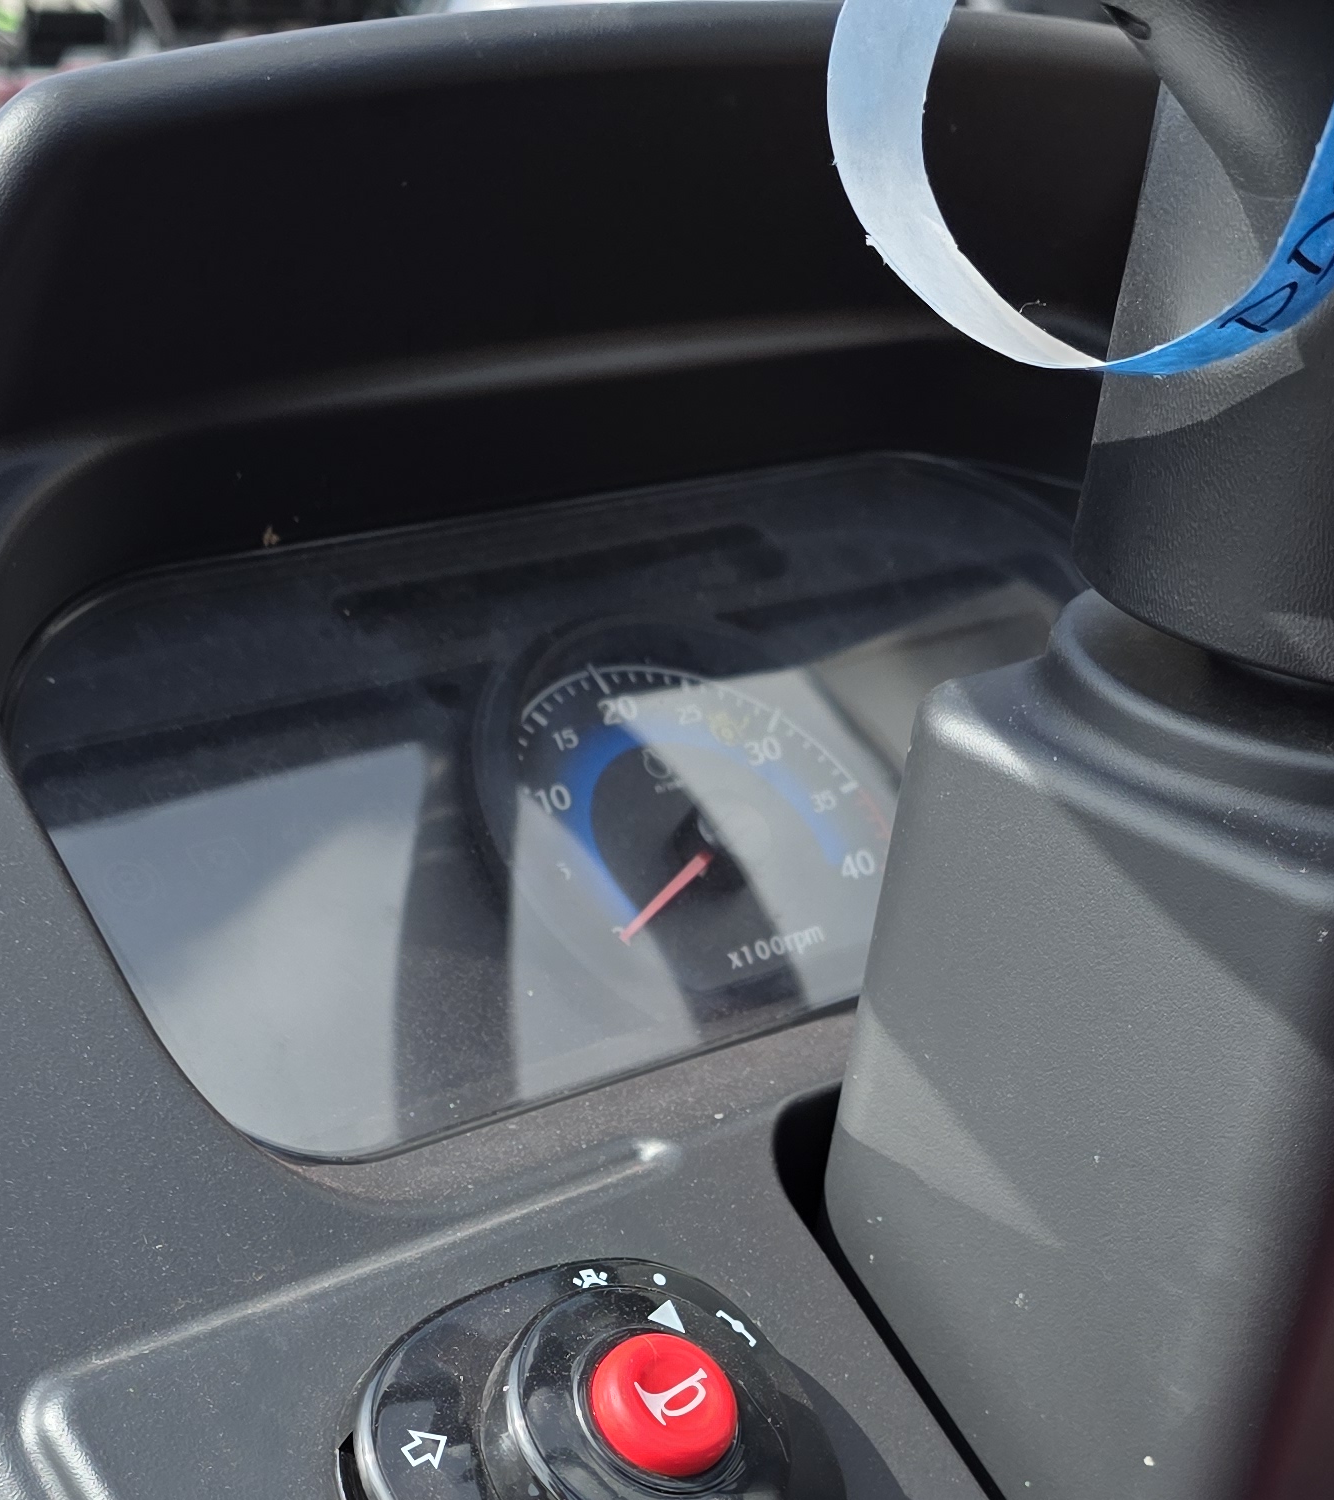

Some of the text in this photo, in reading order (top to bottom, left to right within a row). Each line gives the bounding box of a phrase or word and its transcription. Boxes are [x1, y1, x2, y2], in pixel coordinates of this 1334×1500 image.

[596, 696, 638, 727] 20
[677, 704, 703, 726] 25
[552, 727, 579, 752] 15
[744, 736, 782, 767] 30
[534, 784, 573, 815] 10
[810, 789, 837, 813] 35
[840, 849, 875, 880] 40
[727, 925, 825, 970] x100rpm
